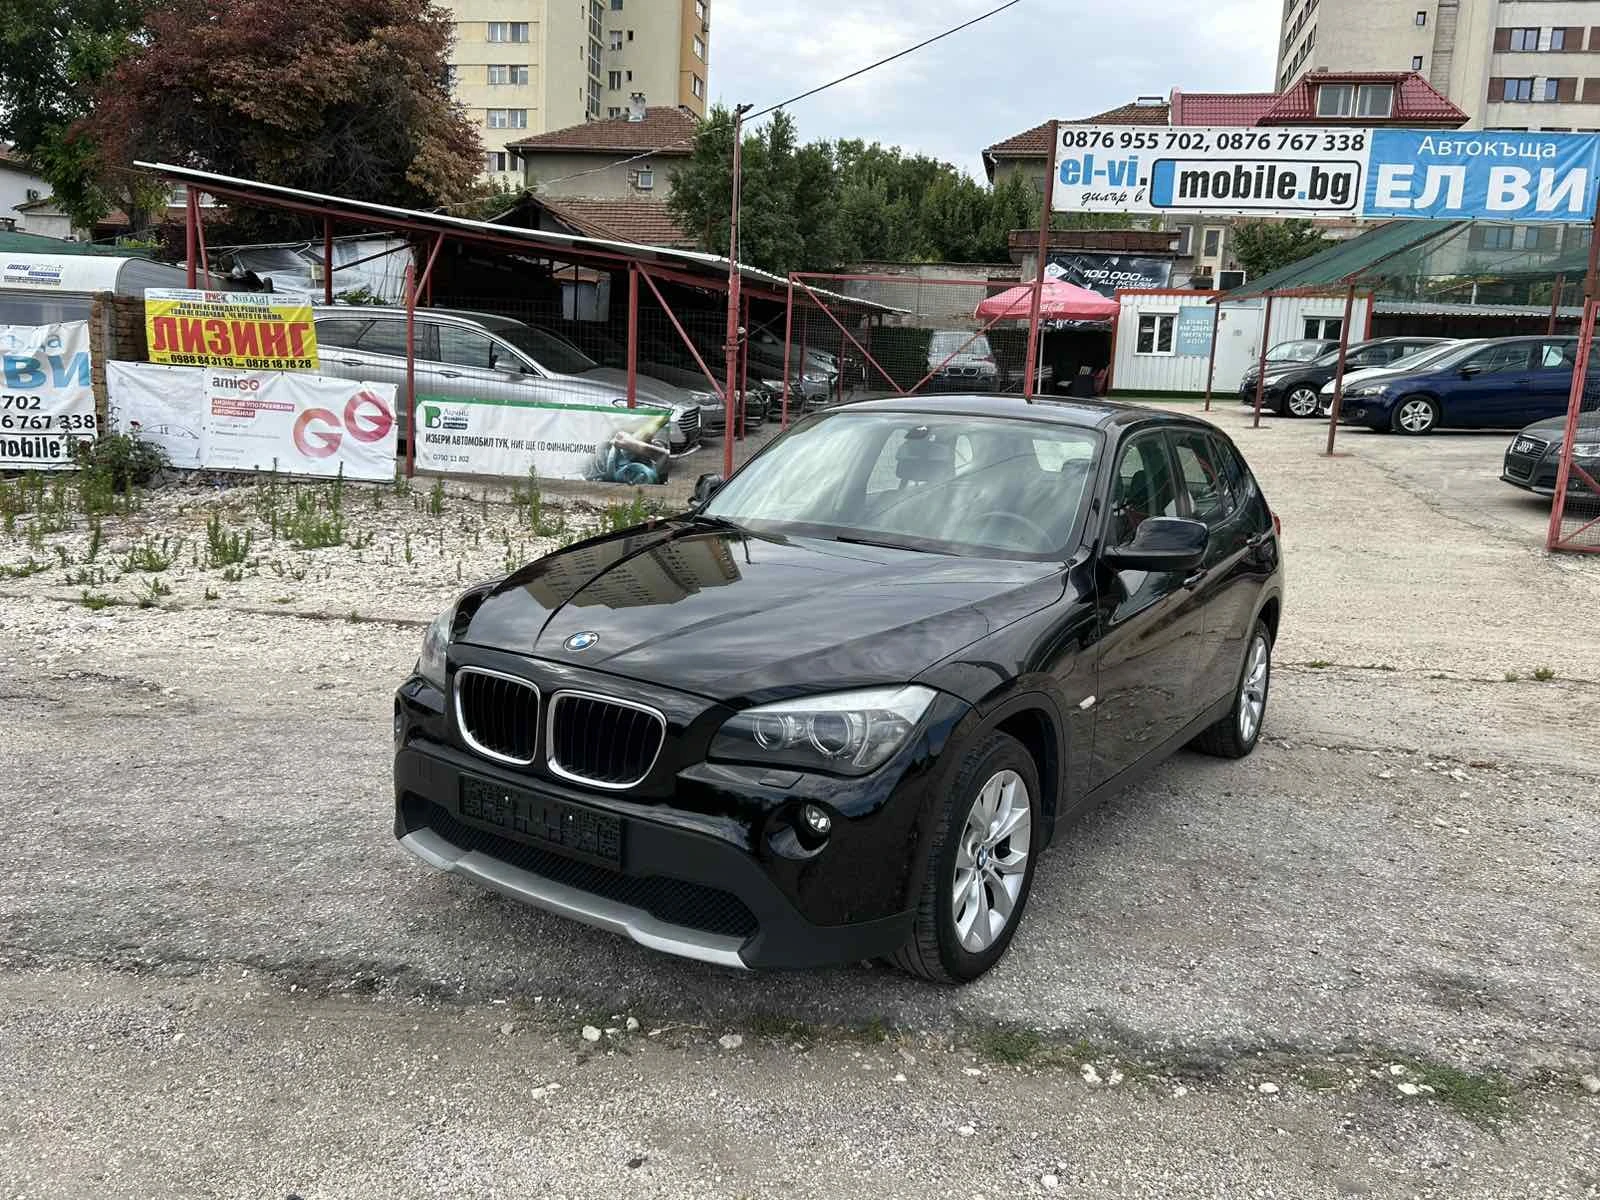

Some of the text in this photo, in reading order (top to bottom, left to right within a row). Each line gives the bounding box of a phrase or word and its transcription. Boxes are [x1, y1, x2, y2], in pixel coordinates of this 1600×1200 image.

[1061, 131, 1365, 153] 0876 955 702, 0876 767 338
[1417, 136, 1558, 162] Автокъща
[1178, 164, 1352, 205] mobile.bg
[1374, 164, 1588, 213] ЕЛ ВИ
[1083, 269, 1110, 279] 100
[1110, 271, 1141, 281] 000
[153, 316, 309, 357] ЛИЗИНГ
[3, 351, 91, 389] ВИ
[171, 354, 197, 364] 0988
[2, 395, 42, 410] 702
[17, 415, 53, 429] 767
[59, 414, 96, 429] 338
[425, 433, 452, 445] ИЗБЕРИ
[452, 435, 494, 448] АВТОМОБИЛ
